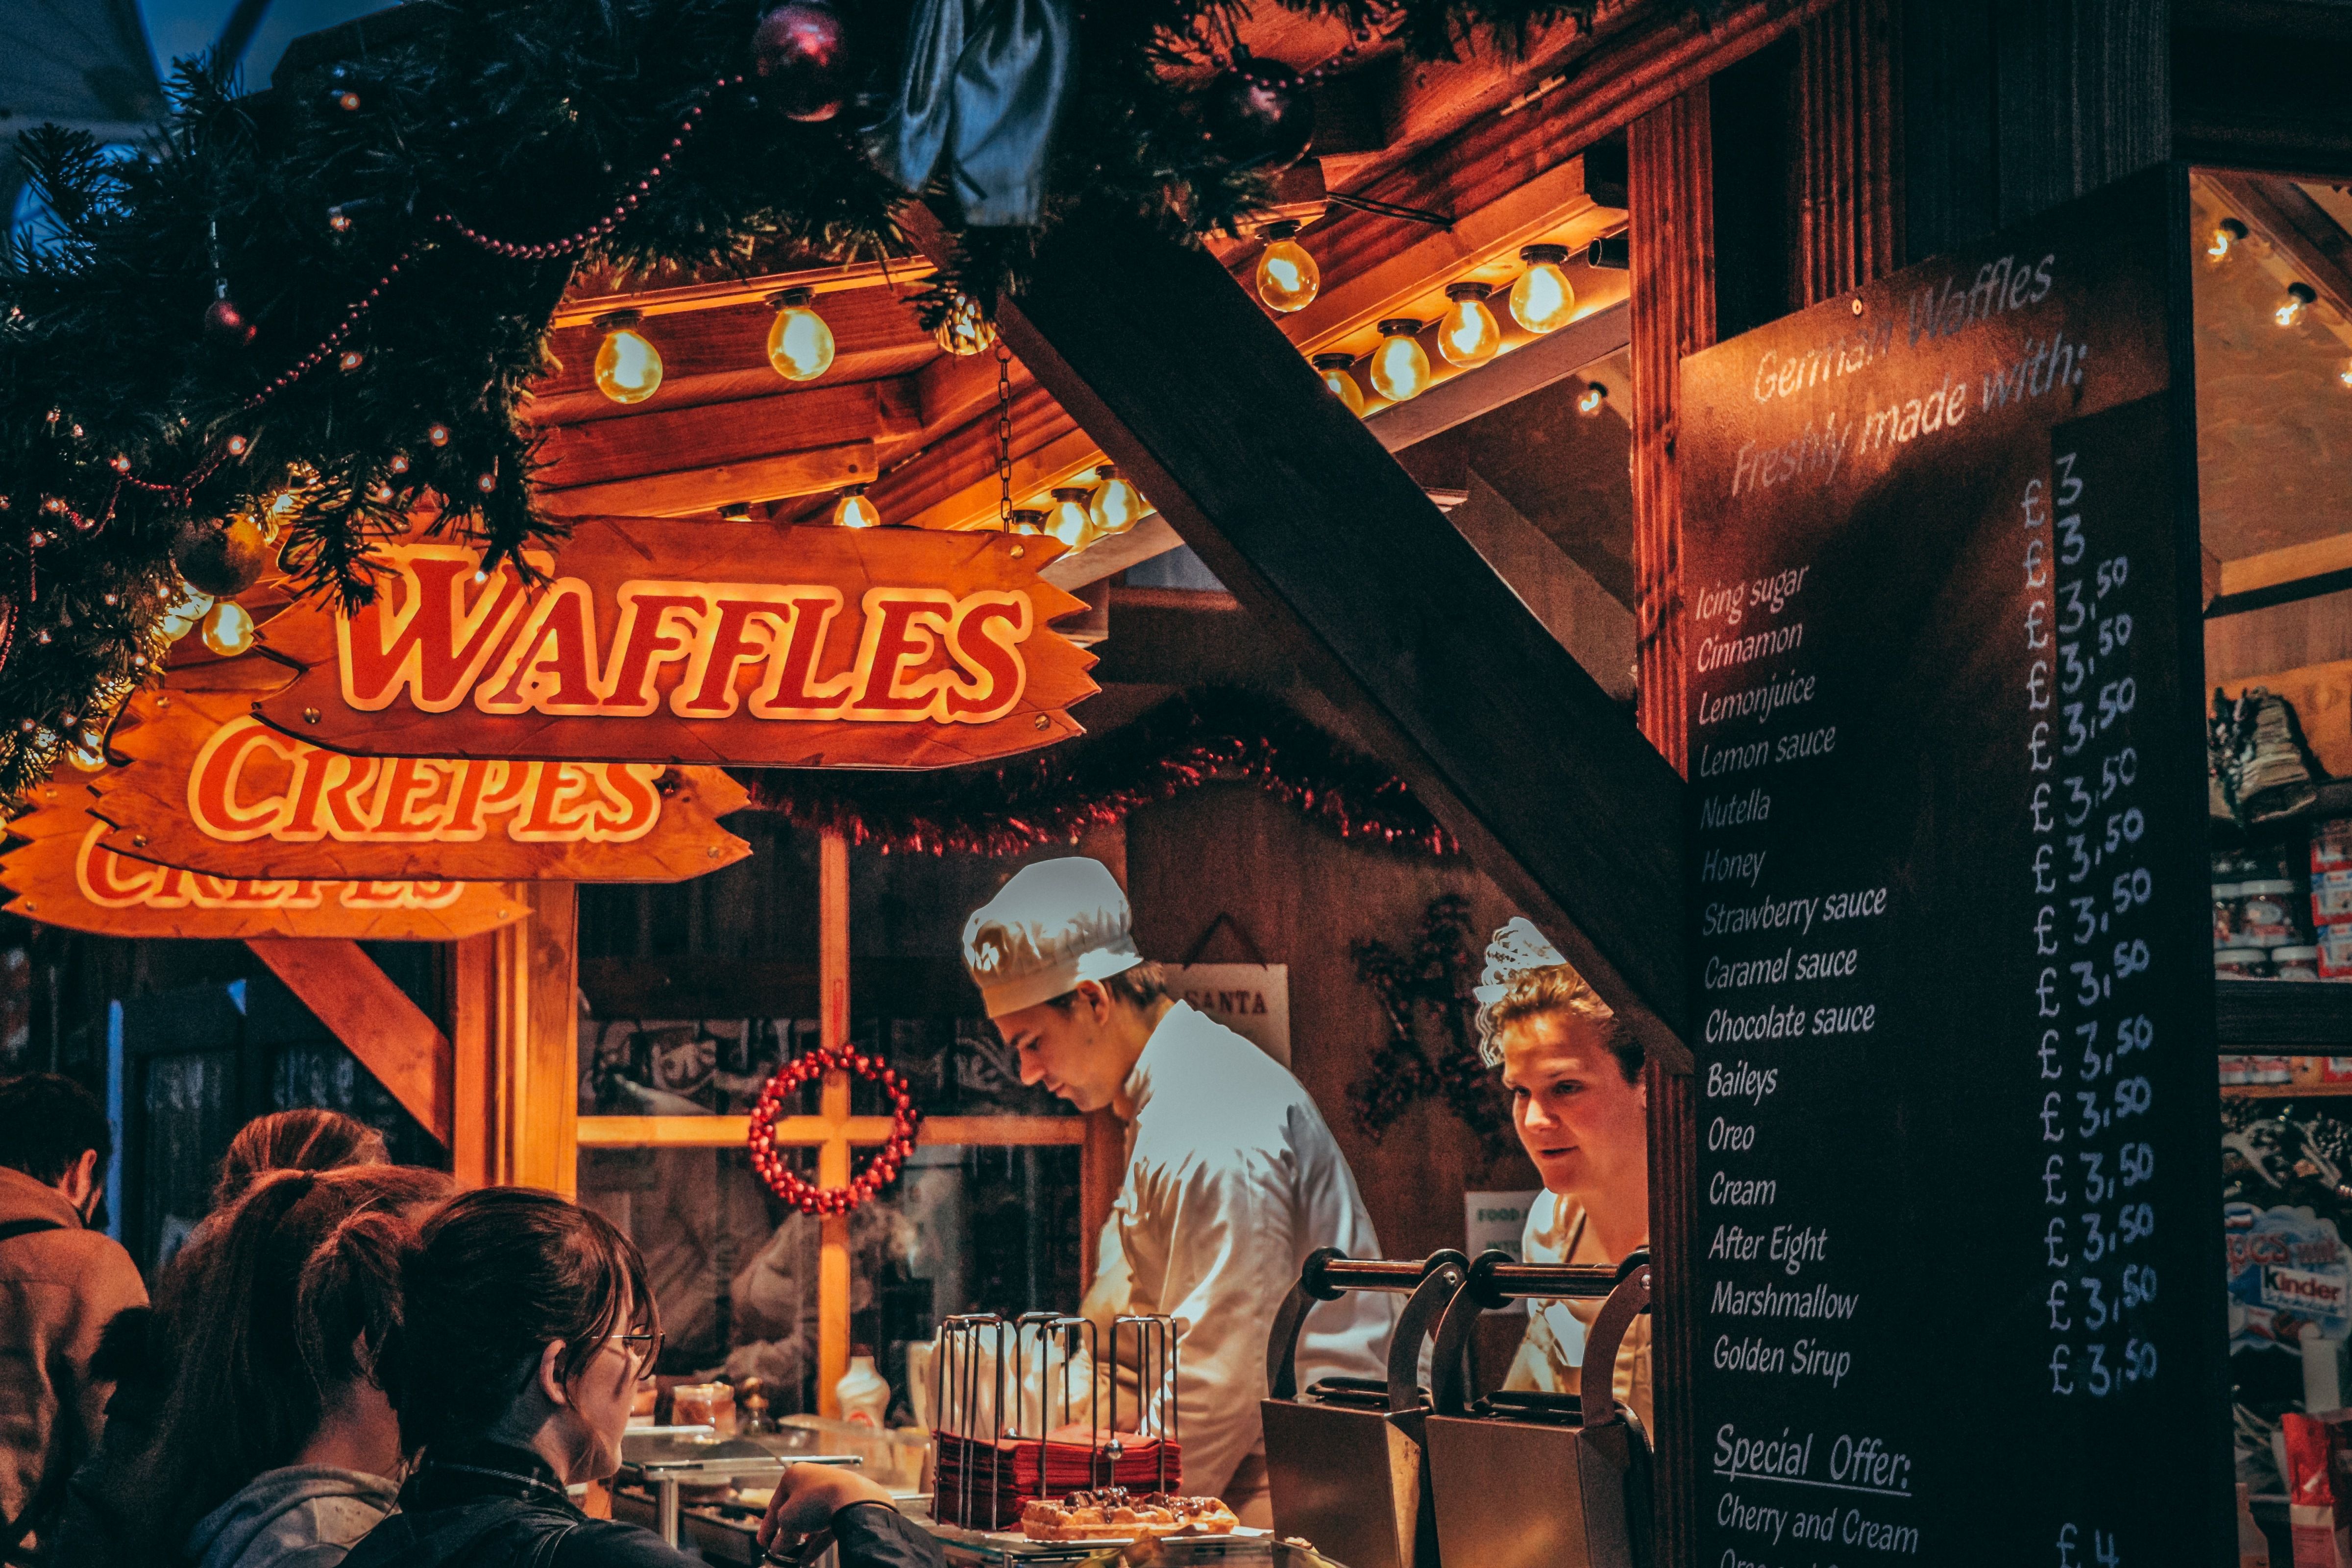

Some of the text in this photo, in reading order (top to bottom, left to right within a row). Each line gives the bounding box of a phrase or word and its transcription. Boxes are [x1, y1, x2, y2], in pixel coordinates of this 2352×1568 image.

[1754, 253, 2055, 404] German Waffles
[1732, 332, 2088, 497] Freshly made with:
[2056, 452, 2083, 506] 3
[2058, 514, 2085, 564] 3
[1695, 565, 1810, 625] Icing sugar
[337, 543, 1032, 723] WAFFLES
[1697, 622, 1803, 673] Cinnamon
[1699, 669, 1815, 725] Lemonjuice
[1701, 726, 1836, 777] Lemon sauce
[188, 715, 662, 841] CREPES
[1700, 787, 1771, 830] Nutella
[1702, 849, 1766, 887] Honey
[1703, 887, 1887, 936] Strawberry sauce
[1705, 947, 1858, 989] Caramel sauce
[1185, 990, 1268, 1015] SANTA
[1706, 1004, 1876, 1043] Chocolate sauce
[1707, 1060, 1778, 1106] Baileys
[1709, 1116, 1755, 1152] Oreo
[1710, 1171, 1776, 1205] Cream
[1708, 1224, 1828, 1274] After Eight
[1711, 1281, 1859, 1320] Marshmallow
[1714, 1334, 1851, 1389] Golden Sirup
[1715, 1423, 1911, 1489] Special Offer:
[1718, 1493, 1919, 1554] Cherry and Cream
